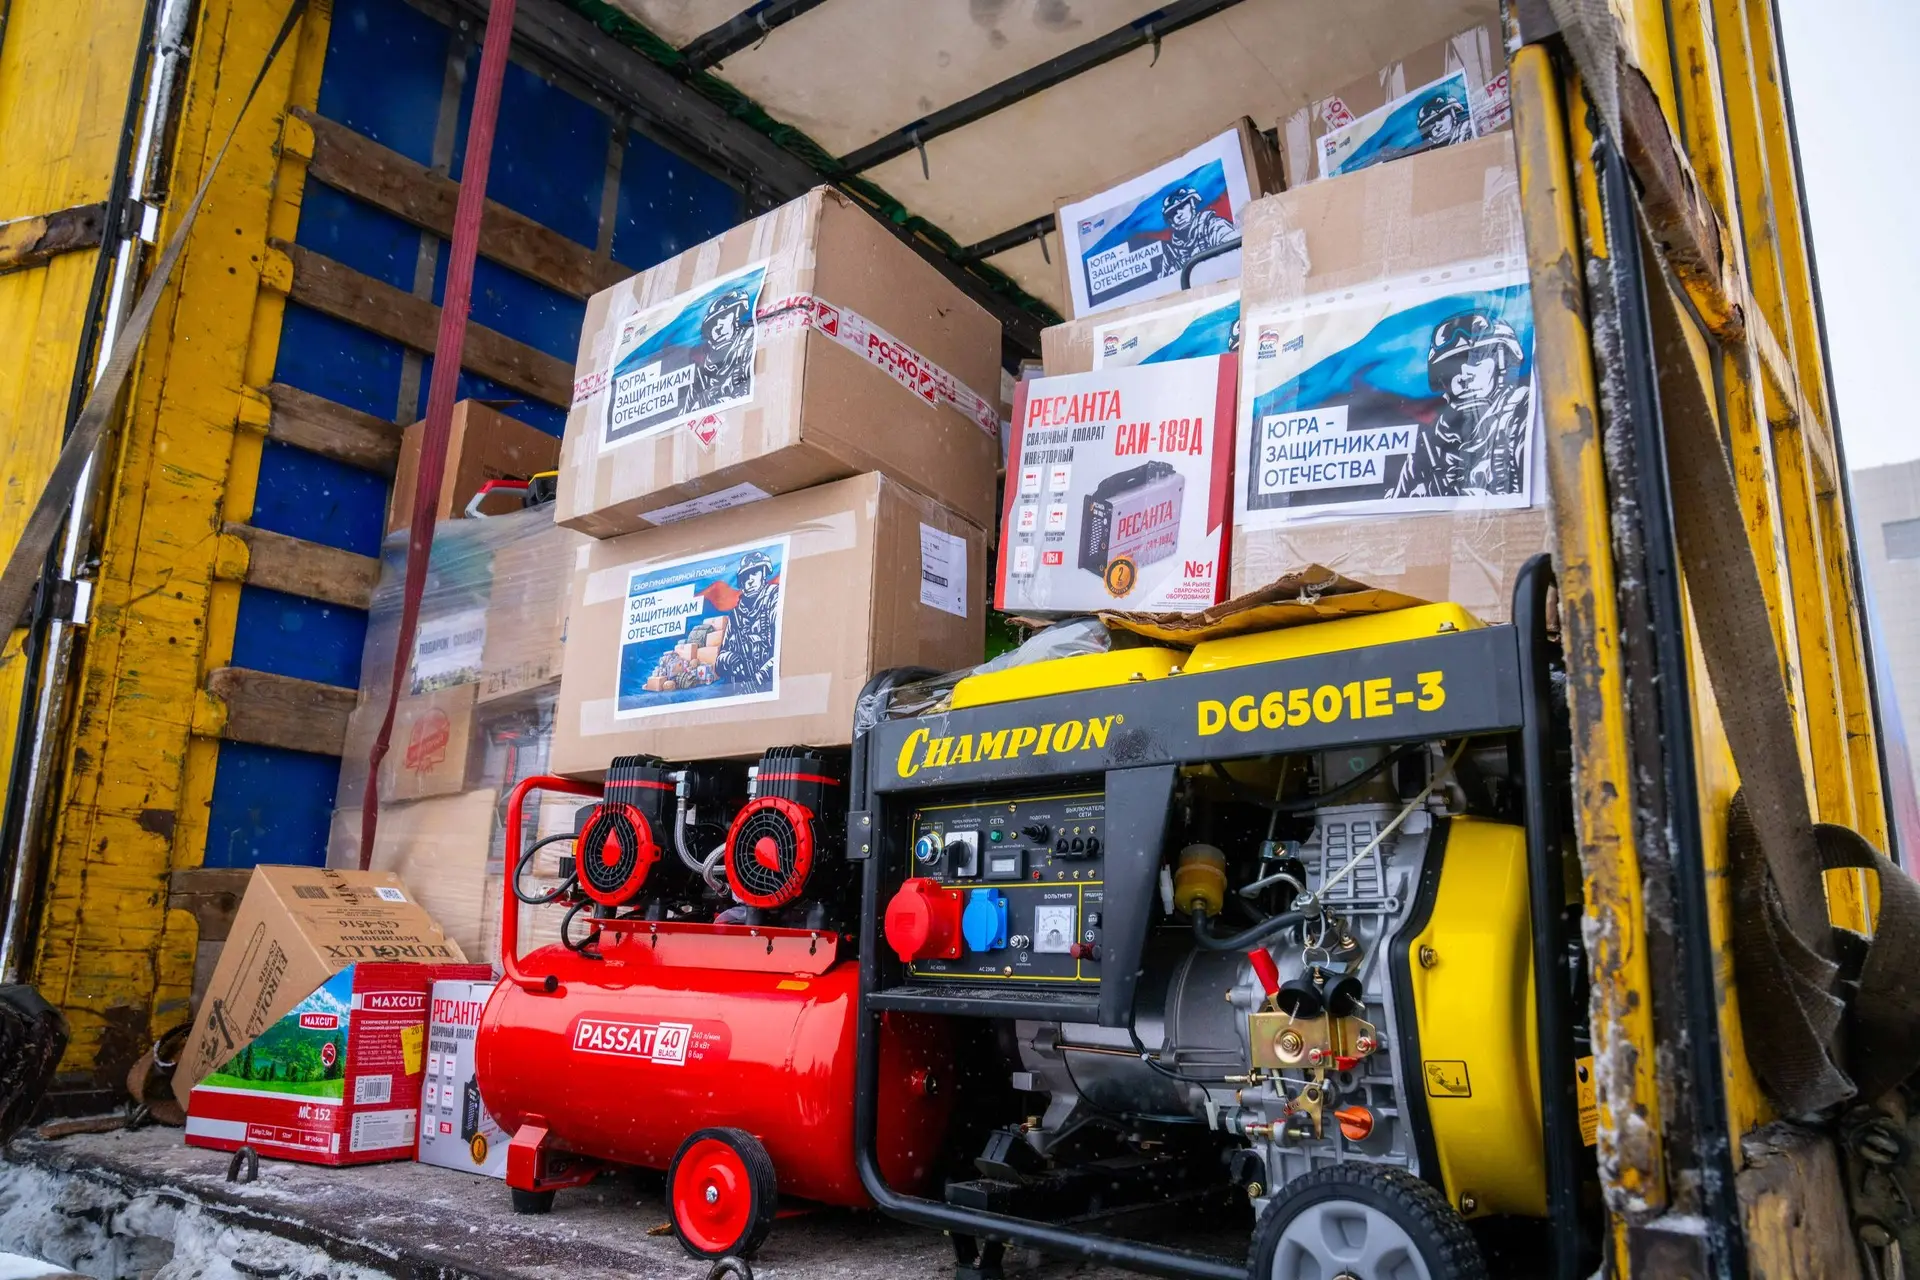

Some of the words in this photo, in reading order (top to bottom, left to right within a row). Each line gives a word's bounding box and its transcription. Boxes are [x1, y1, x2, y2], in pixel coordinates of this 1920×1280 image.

[1090, 251, 1117, 269] ЮГРА
[1092, 244, 1160, 279] ЗАЩИТНИКАМ
[1093, 262, 1148, 291] ОТЕЧЕСТВА
[868, 333, 919, 379] РОСКО
[616, 369, 691, 408] ЗАЩИТНИКАМ
[619, 372, 646, 392] ЮГРА
[614, 392, 674, 424] ОТЕЧЕСТВА
[1028, 390, 1122, 428] РЕСАНТА
[1026, 427, 1069, 446] СВАРОЧНЫЙ
[1071, 426, 1106, 442] АППАРАТ
[1115, 417, 1203, 456] САИ-189Д
[1268, 416, 1319, 439] ЮГРА
[1024, 446, 1074, 466] ИНВЕРТОРНЫЙ
[1266, 431, 1409, 463] ЗАЩИТНИКАМ
[1264, 461, 1376, 487] ОТЕЧЕСТВА
[1117, 500, 1173, 540] РЕСАНТА
[634, 583, 649, 591] СБОР
[649, 572, 696, 588] ГУМАНИТАРНОЙ
[696, 564, 727, 578] ПОМОЩИ
[629, 602, 698, 625] ЗАЩИТНИКАМ
[631, 596, 656, 611] ЮГРА
[628, 621, 682, 640] ОТЕЧЕСТВА
[419, 637, 450, 655] ПОДАРОК
[1198, 670, 1446, 736] DG6501E-3
[1066, 805, 1105, 813] ВЫКЛЮЧАТЕЛЬ
[339, 920, 400, 929] GS-4516
[259, 939, 278, 983] GS-4516
[372, 996, 423, 1008] MAXCUT
[432, 999, 483, 1026] РЕСАНТА
[305, 1016, 333, 1026] MAXCUT
[431, 1025, 454, 1038] СВАРОЧНЫЙ
[578, 1024, 657, 1053] PASSAT
[661, 1030, 681, 1049] 40
[692, 1032, 703, 1040] 340
[430, 1040, 458, 1054] ИНВЕРТОРНЫЙ
[658, 1049, 677, 1058] BLACK
[693, 1051, 704, 1060] бар
[299, 1105, 312, 1119] MC
[315, 1108, 331, 1120] 152
